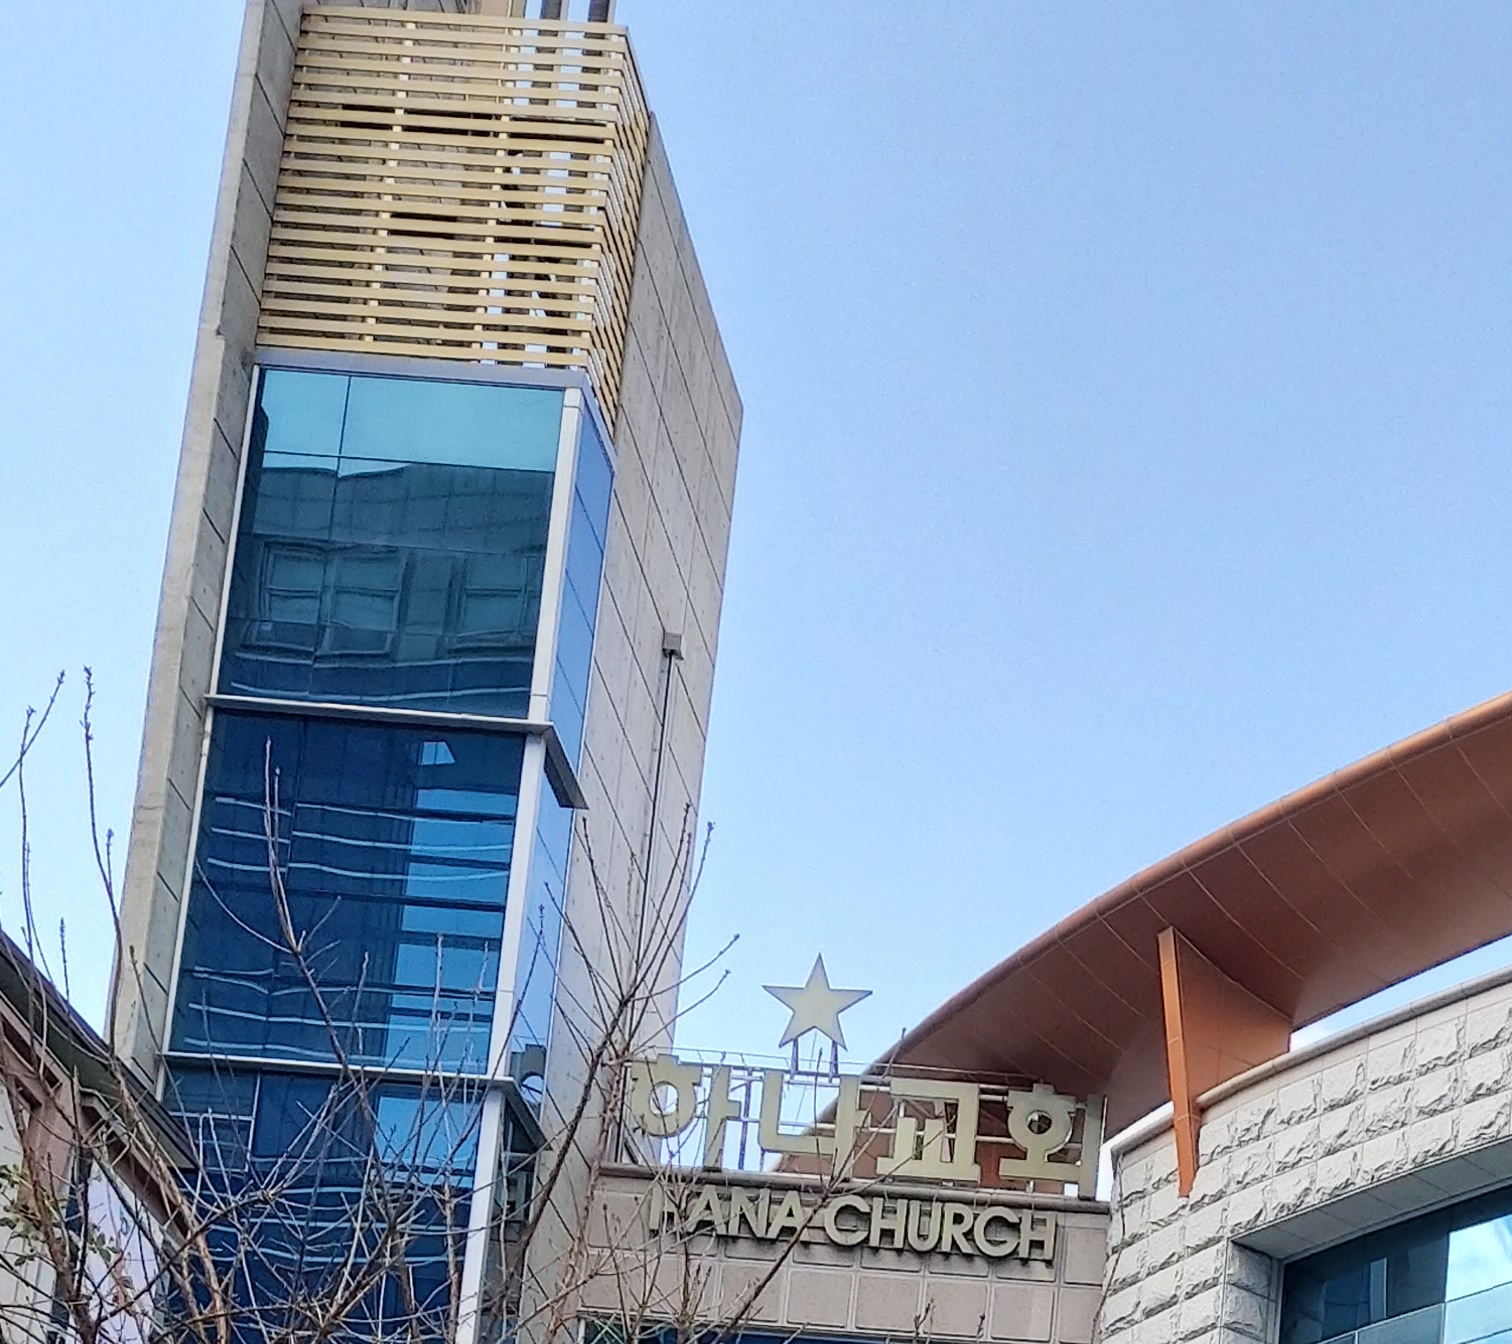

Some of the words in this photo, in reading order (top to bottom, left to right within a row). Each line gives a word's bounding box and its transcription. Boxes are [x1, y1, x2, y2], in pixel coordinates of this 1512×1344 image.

[630, 1054, 1106, 1200] 하나교회
[649, 1183, 805, 1240] HANA
[823, 1194, 1058, 1262] CHURCH
